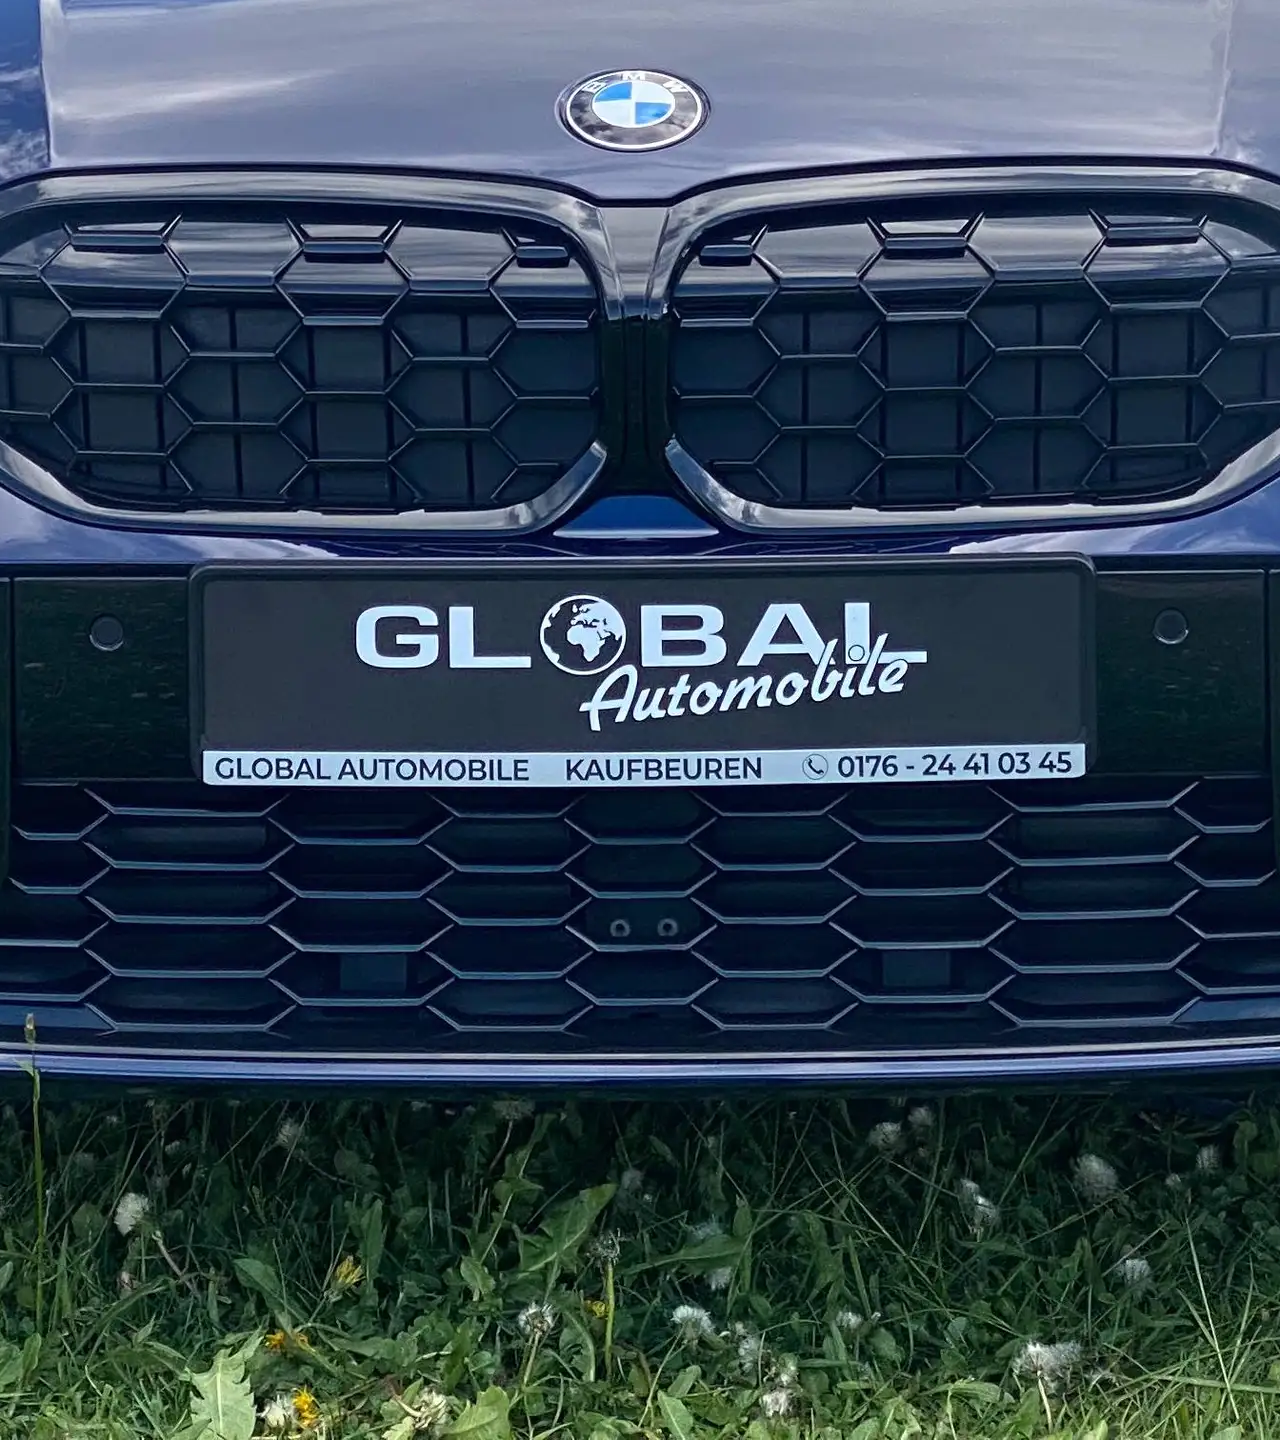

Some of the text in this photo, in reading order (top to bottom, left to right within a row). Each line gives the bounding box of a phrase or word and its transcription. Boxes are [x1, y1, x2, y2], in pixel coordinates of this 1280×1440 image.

[355, 594, 927, 675] GLOBAL
[579, 632, 909, 732] Automobile
[215, 757, 332, 780] GLOBAL
[337, 758, 530, 781] AUTOMOBILE
[565, 757, 763, 780] KAUFBEUREN
[837, 754, 899, 777] 0176
[922, 753, 957, 776] 24
[963, 752, 990, 775] 41
[997, 751, 1031, 774] 03
[1038, 751, 1073, 773] 45
